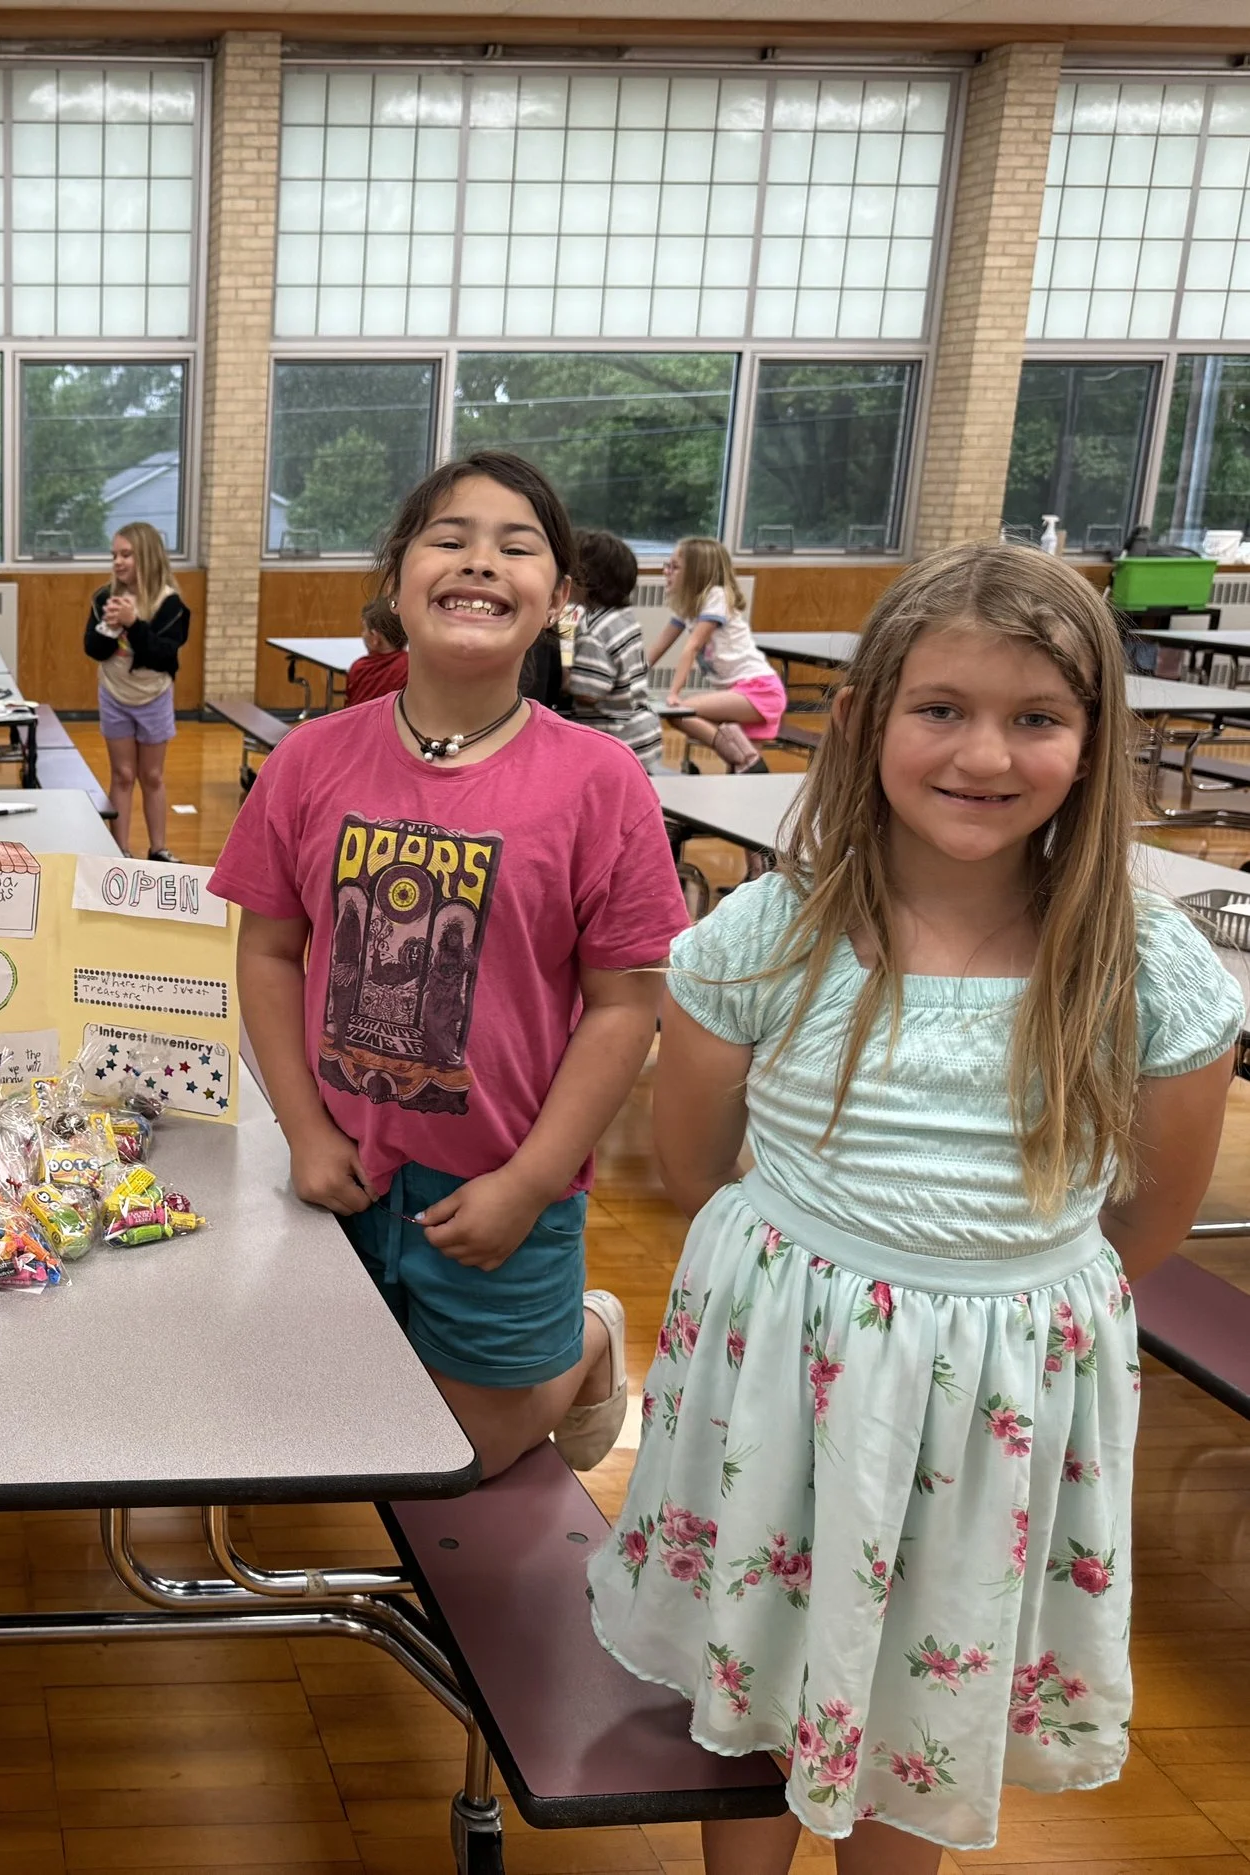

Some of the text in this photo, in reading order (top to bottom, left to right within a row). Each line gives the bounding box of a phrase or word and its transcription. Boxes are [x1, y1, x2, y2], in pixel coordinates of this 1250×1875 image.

[337, 824, 493, 911] DOORS
[101, 866, 199, 914] OPEN
[139, 983, 164, 995] the
[99, 1025, 214, 1056] Interest Inventory
[48, 1157, 100, 1173] DOTS
